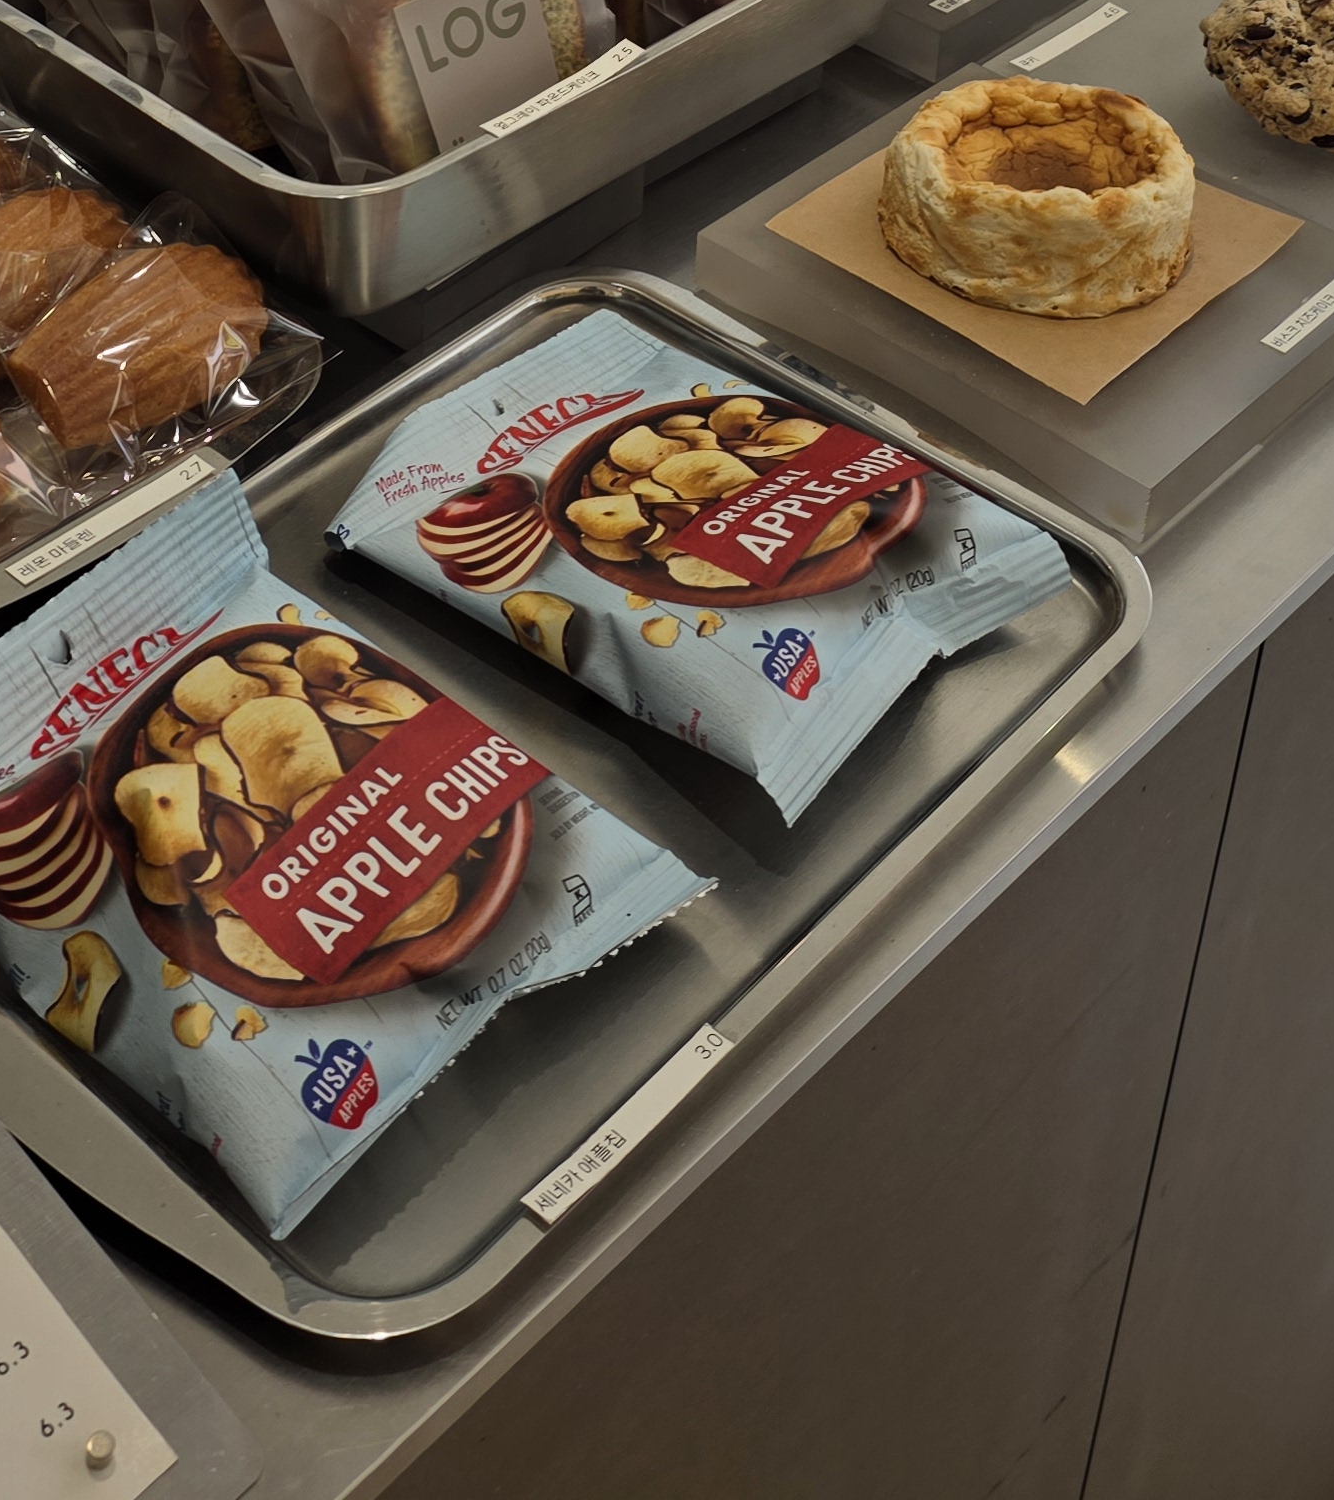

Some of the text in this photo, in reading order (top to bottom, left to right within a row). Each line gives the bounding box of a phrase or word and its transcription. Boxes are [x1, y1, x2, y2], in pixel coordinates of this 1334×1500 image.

[1103, 6, 1121, 20] 4.6
[538, 69, 601, 108] 파운드케이크
[611, 45, 633, 63] 2.5
[375, 461, 445, 495] Made From
[383, 470, 466, 508] Fresh Apples
[702, 468, 811, 536] ORIGINAL
[18, 459, 205, 579] 레몬 마들렌 2.7
[735, 479, 851, 565] APPLE
[906, 565, 936, 593] (20g)
[772, 638, 805, 679] USA
[789, 654, 818, 696] APPLES
[261, 765, 402, 900] ORIGINAL
[295, 735, 529, 955] APPLE CHIPS
[434, 929, 553, 1032] NET WT 0.7 OZ (20g)
[311, 1055, 357, 1106] USA
[337, 1071, 376, 1125] APPLES
[535, 1031, 725, 1216] 세네카 애플칩 3.0
[39, 1401, 77, 1440] 6.3
